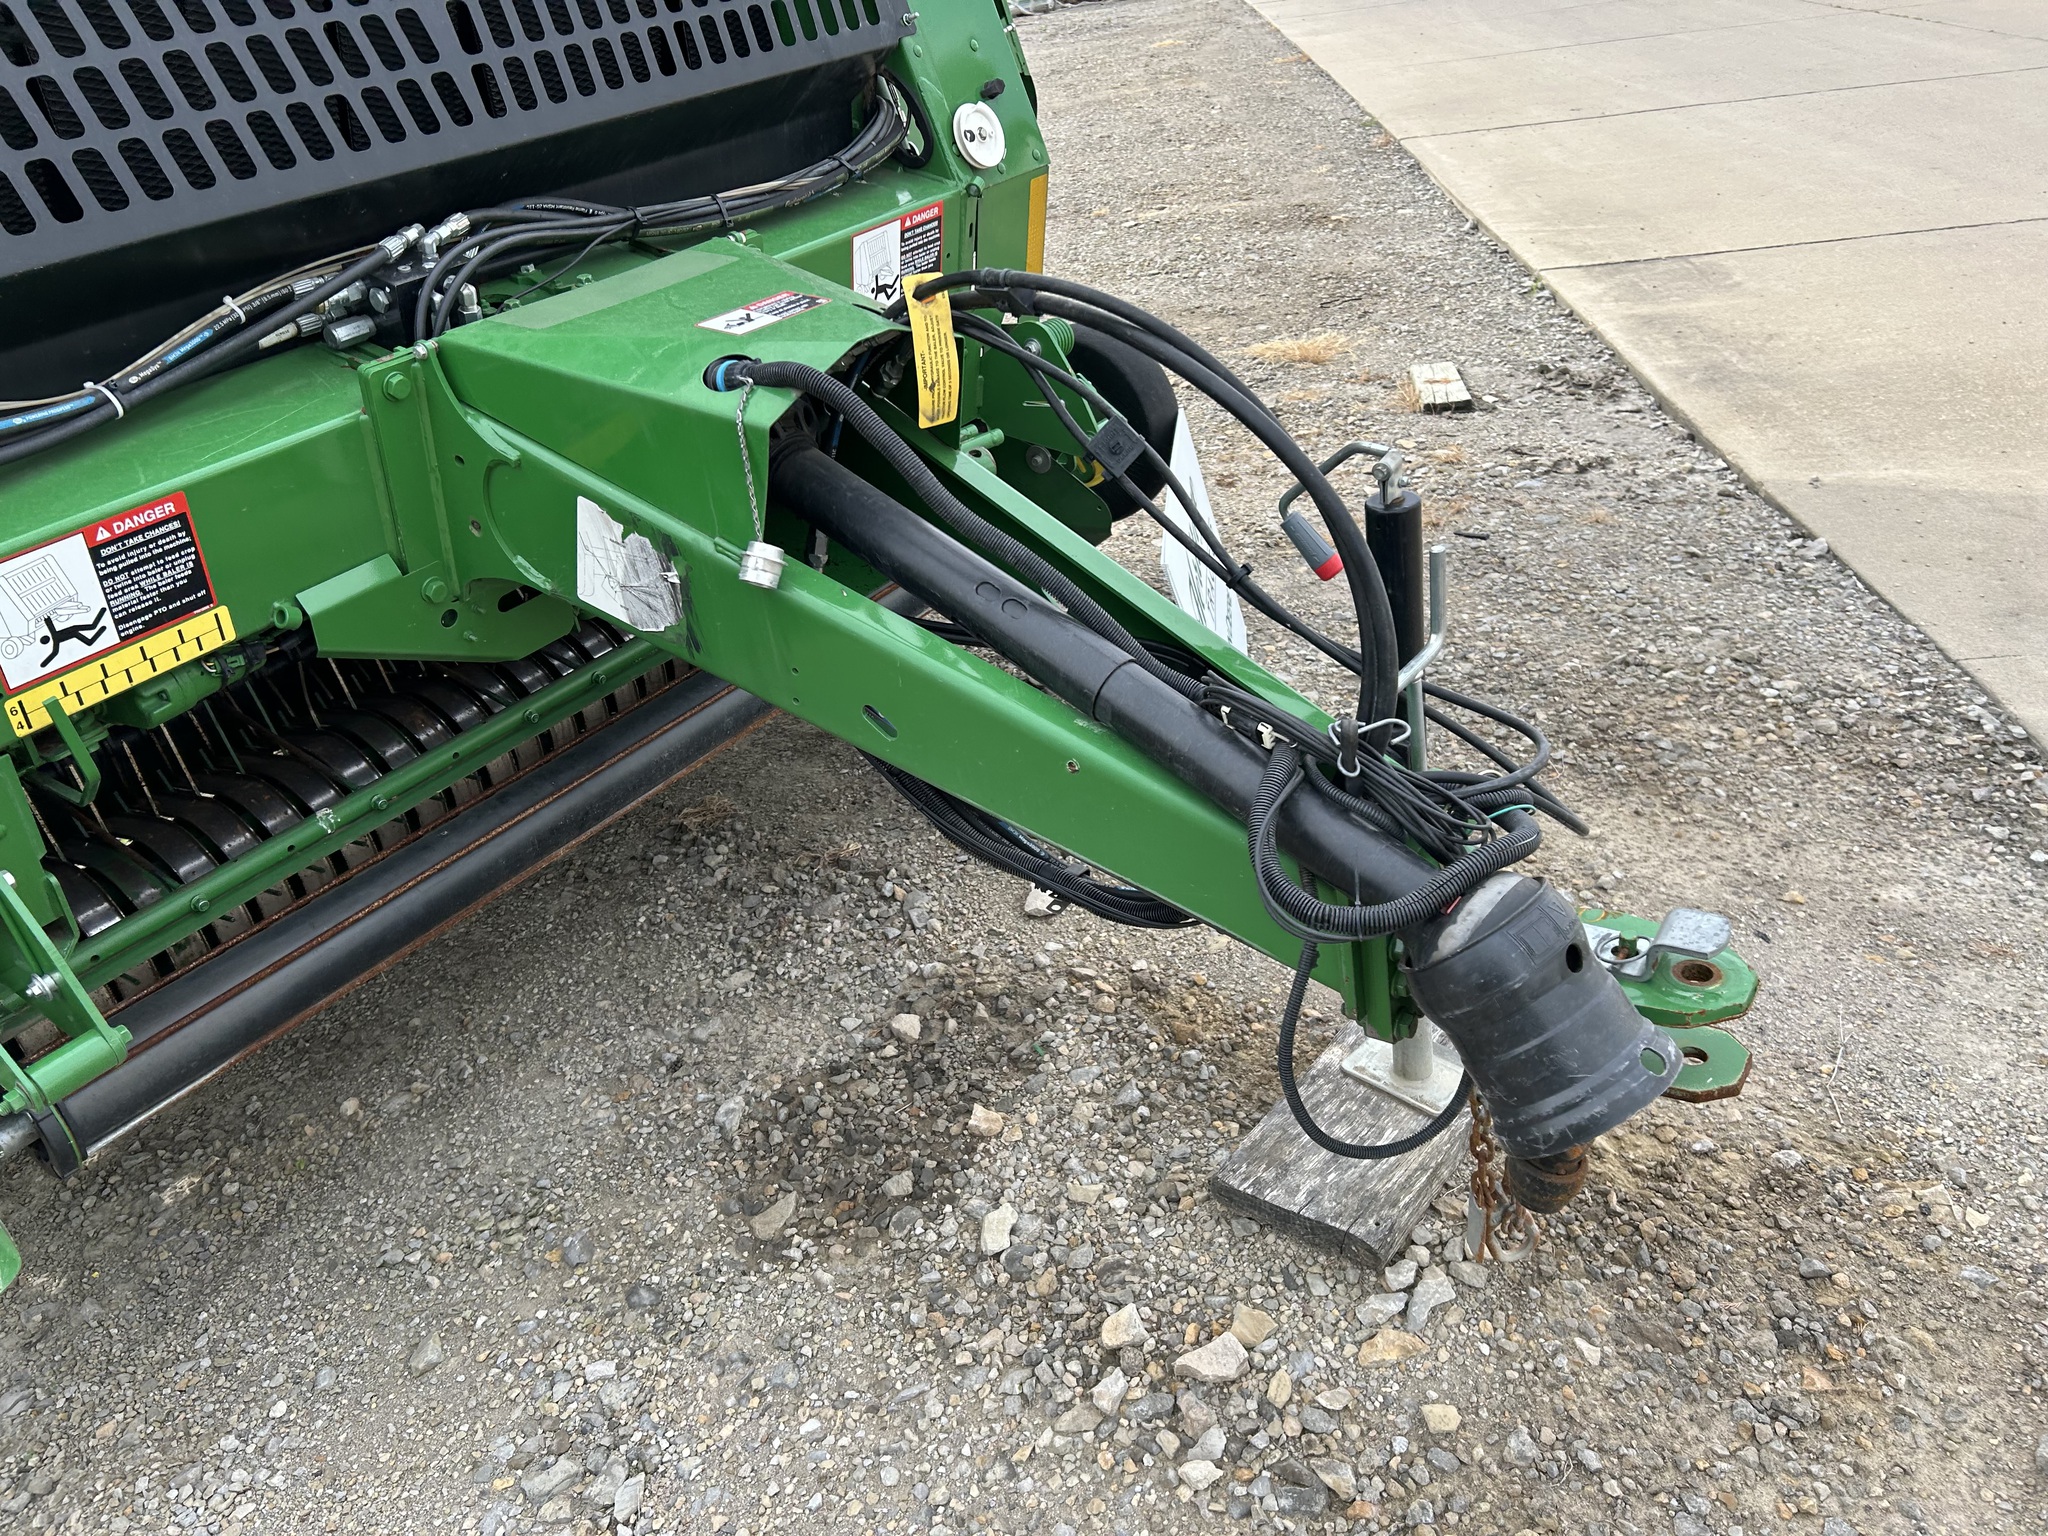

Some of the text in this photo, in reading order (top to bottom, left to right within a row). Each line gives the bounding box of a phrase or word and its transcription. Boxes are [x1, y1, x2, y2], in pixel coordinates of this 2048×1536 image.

[913, 206, 939, 224] DANGER
[113, 502, 176, 534] DANGER
[100, 542, 124, 556] DON'T
[124, 535, 144, 547] TAKE
[107, 554, 126, 565] avoid
[127, 546, 148, 558] injury
[158, 534, 177, 545] death
[99, 566, 118, 577] being
[119, 558, 139, 569] pulled
[114, 579, 132, 590] twine
[134, 574, 146, 582] into
[148, 567, 164, 576] baler
[174, 554, 196, 567] unplug
[115, 573, 130, 582] NOT
[131, 563, 154, 576] attempt
[166, 553, 180, 561] feed
[181, 547, 196, 556] crop
[108, 591, 123, 600] feed
[124, 585, 139, 593] area
[140, 575, 162, 588] WHILE
[163, 565, 185, 578] BALER
[145, 584, 157, 592] The
[158, 577, 174, 586] baler
[175, 569, 192, 580] feeds
[112, 578, 188, 613] material faster than you
[129, 600, 153, 613] release
[118, 590, 206, 632] Disengage PTO and shut off
[10, 706, 18, 716] 6
[17, 721, 24, 729] 4
